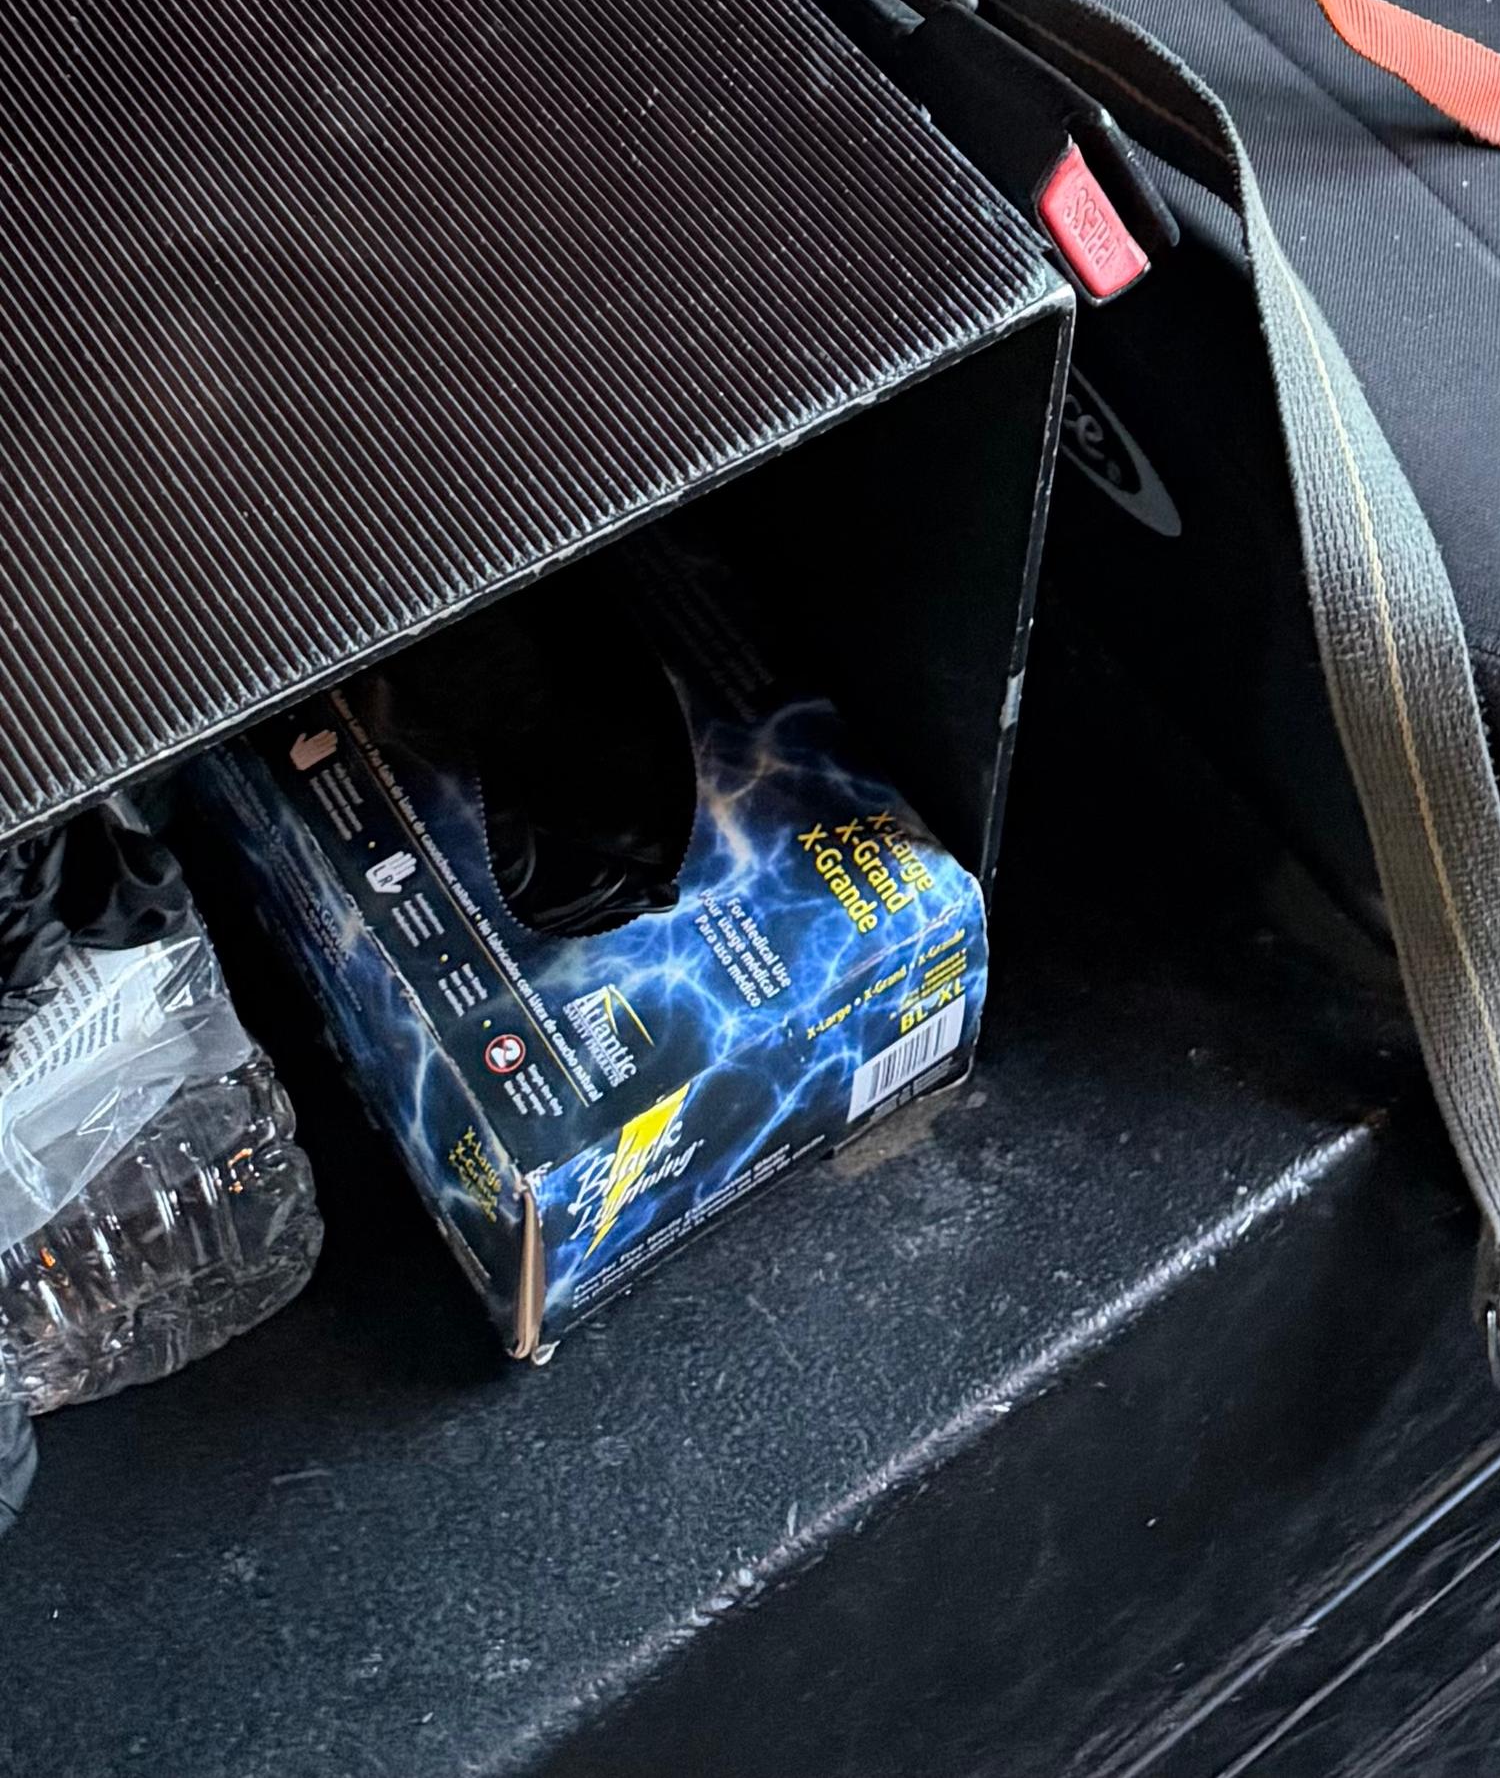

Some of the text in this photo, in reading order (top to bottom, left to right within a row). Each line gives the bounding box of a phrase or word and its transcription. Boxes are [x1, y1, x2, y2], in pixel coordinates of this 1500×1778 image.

[1063, 186, 1121, 270] PRESS
[796, 821, 880, 936] X-Grande
[834, 817, 916, 915] X-Grand
[866, 809, 936, 893] X-Large
[694, 913, 763, 1009] Para uso médico
[699, 887, 782, 1000] Pour usage médical
[726, 896, 793, 991] For Medical Use
[486, 931, 523, 981] fabricados
[550, 1030, 580, 1067] caucho
[571, 1063, 602, 1102] natural
[562, 1003, 591, 1039] SAFETY
[573, 985, 638, 1080] Atlantic
[805, 1003, 853, 1041] X-Large
[863, 963, 908, 1002] X-Grand
[567, 1119, 684, 1216] Black
